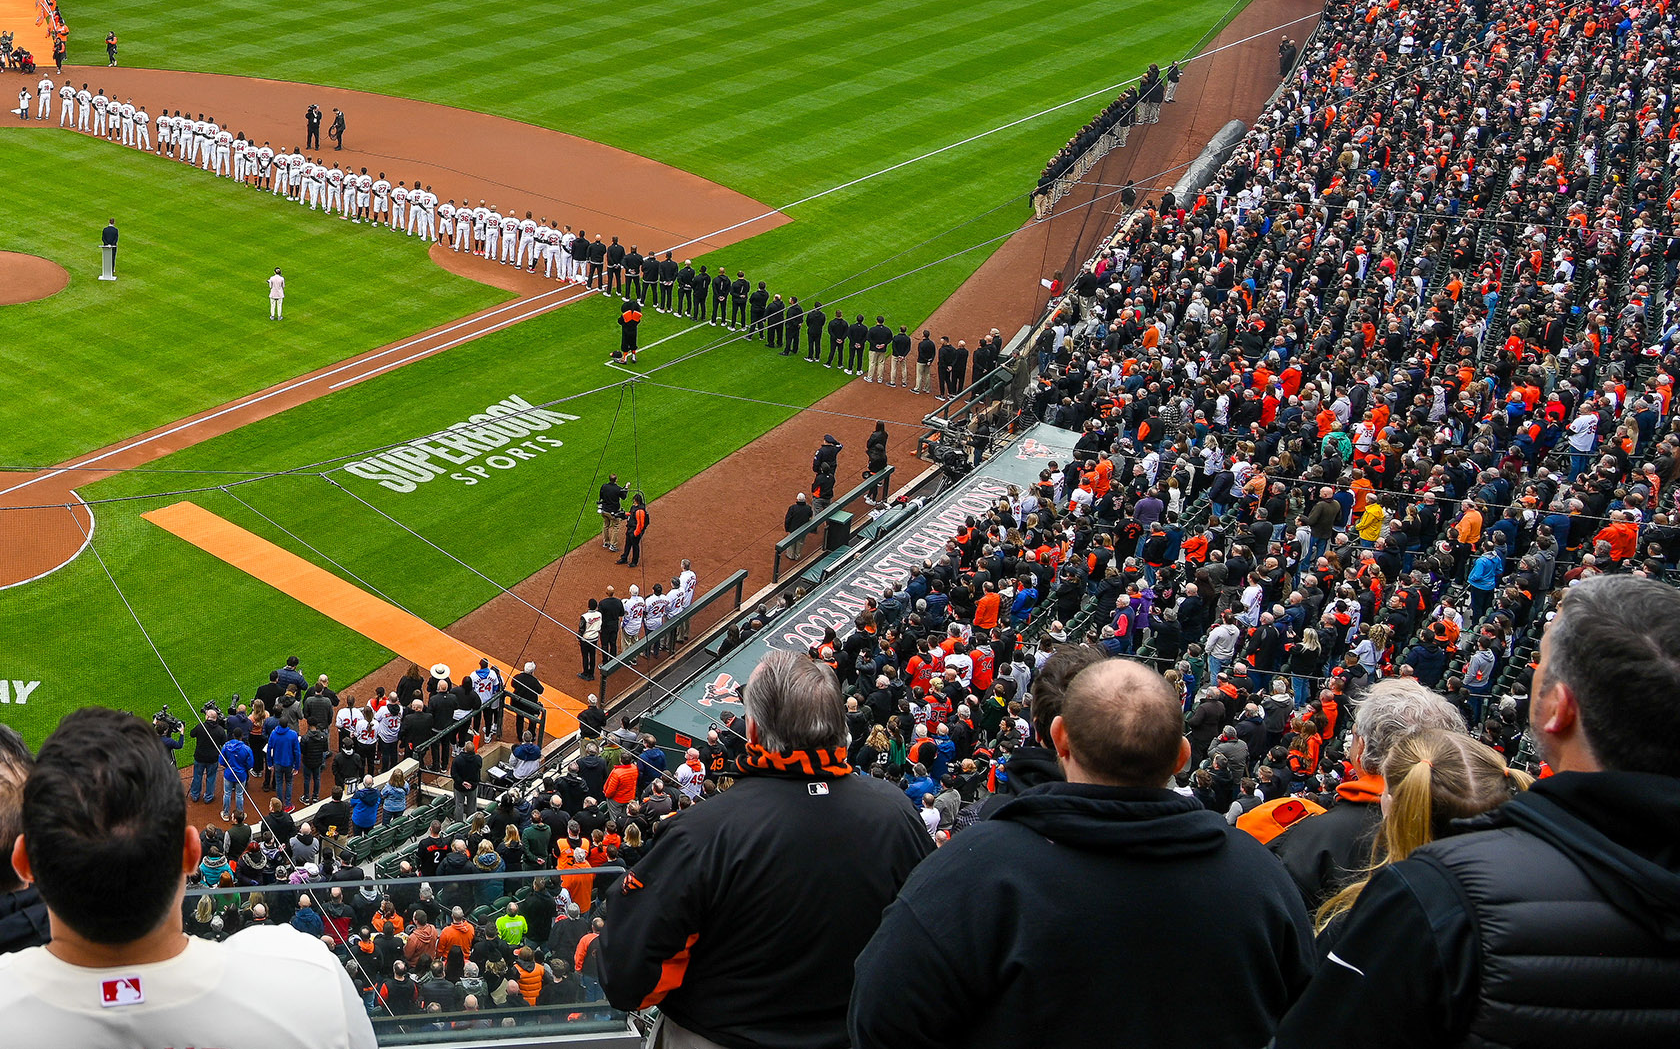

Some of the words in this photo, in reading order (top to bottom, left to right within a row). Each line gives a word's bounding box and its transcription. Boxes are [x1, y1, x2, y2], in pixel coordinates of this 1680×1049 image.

[343, 393, 582, 493] SUPERBOOK
[450, 435, 564, 486] SPORTS
[1128, 529, 1135, 539] 2
[783, 607, 851, 649] 2023
[829, 590, 866, 617] AL
[850, 552, 912, 599] EAST
[896, 481, 1009, 559] CHAMPIONS
[633, 609, 643, 618] 24
[653, 605, 665, 615] 24
[981, 661, 992, 672] 34
[919, 668, 932, 679] 35
[478, 682, 491, 693] 24
[930, 710, 947, 722] 35
[388, 718, 398, 728] 31
[361, 729, 375, 740] 24
[710, 757, 724, 771] 49
[690, 774, 704, 786] 49
[433, 851, 440, 864] 2
